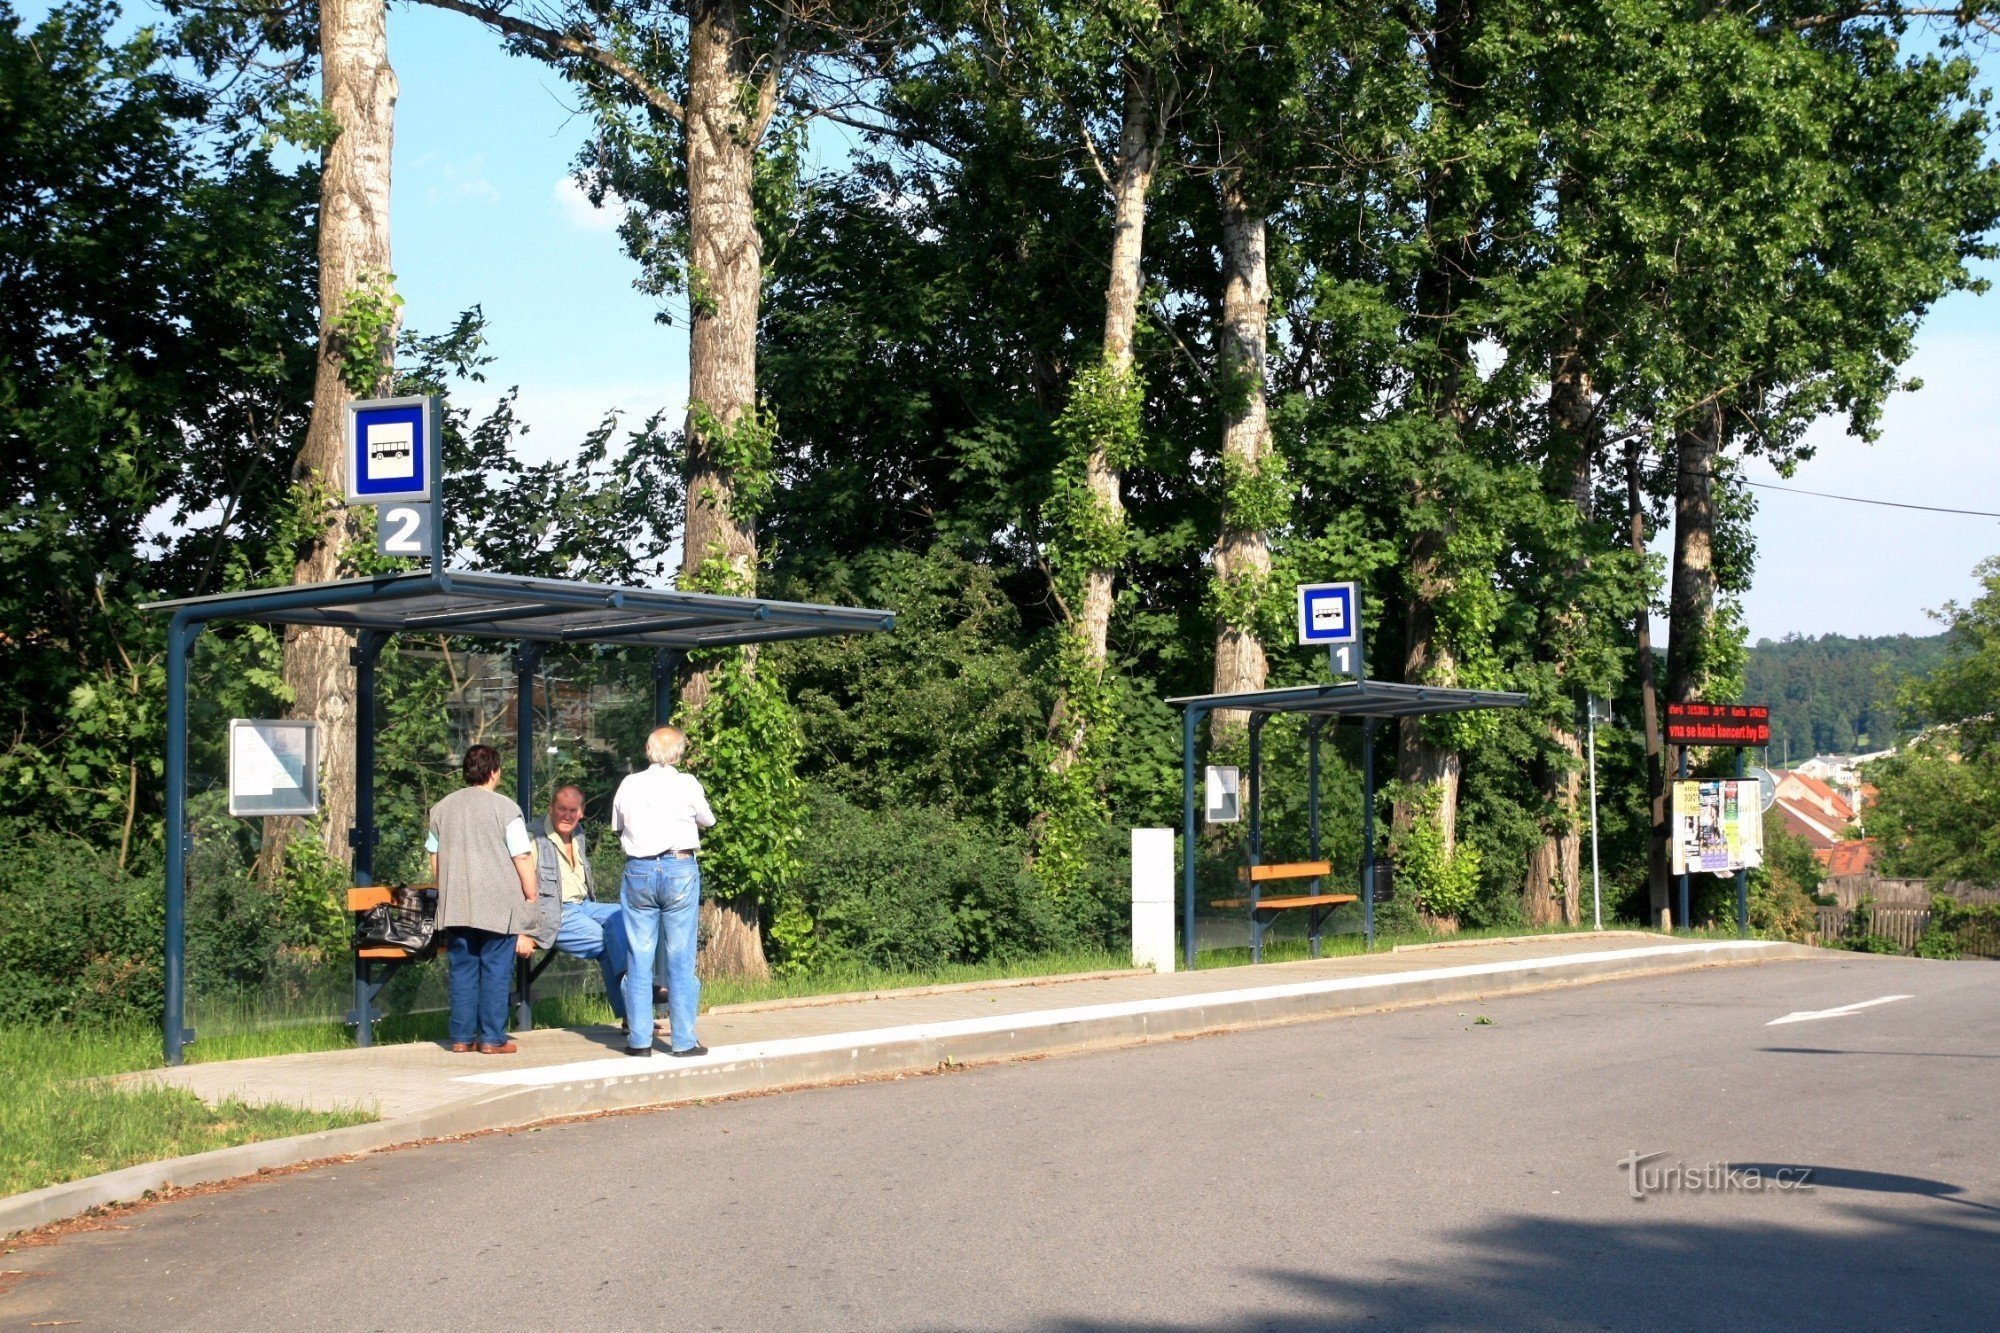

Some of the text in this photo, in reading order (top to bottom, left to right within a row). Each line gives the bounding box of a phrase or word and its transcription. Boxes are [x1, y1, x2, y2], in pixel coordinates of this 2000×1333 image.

[385, 508, 421, 551] 2
[1336, 646, 1349, 672] 1
[1686, 726, 1696, 738] se
[1697, 723, 1716, 738] koná
[1717, 723, 1746, 739] koncert
